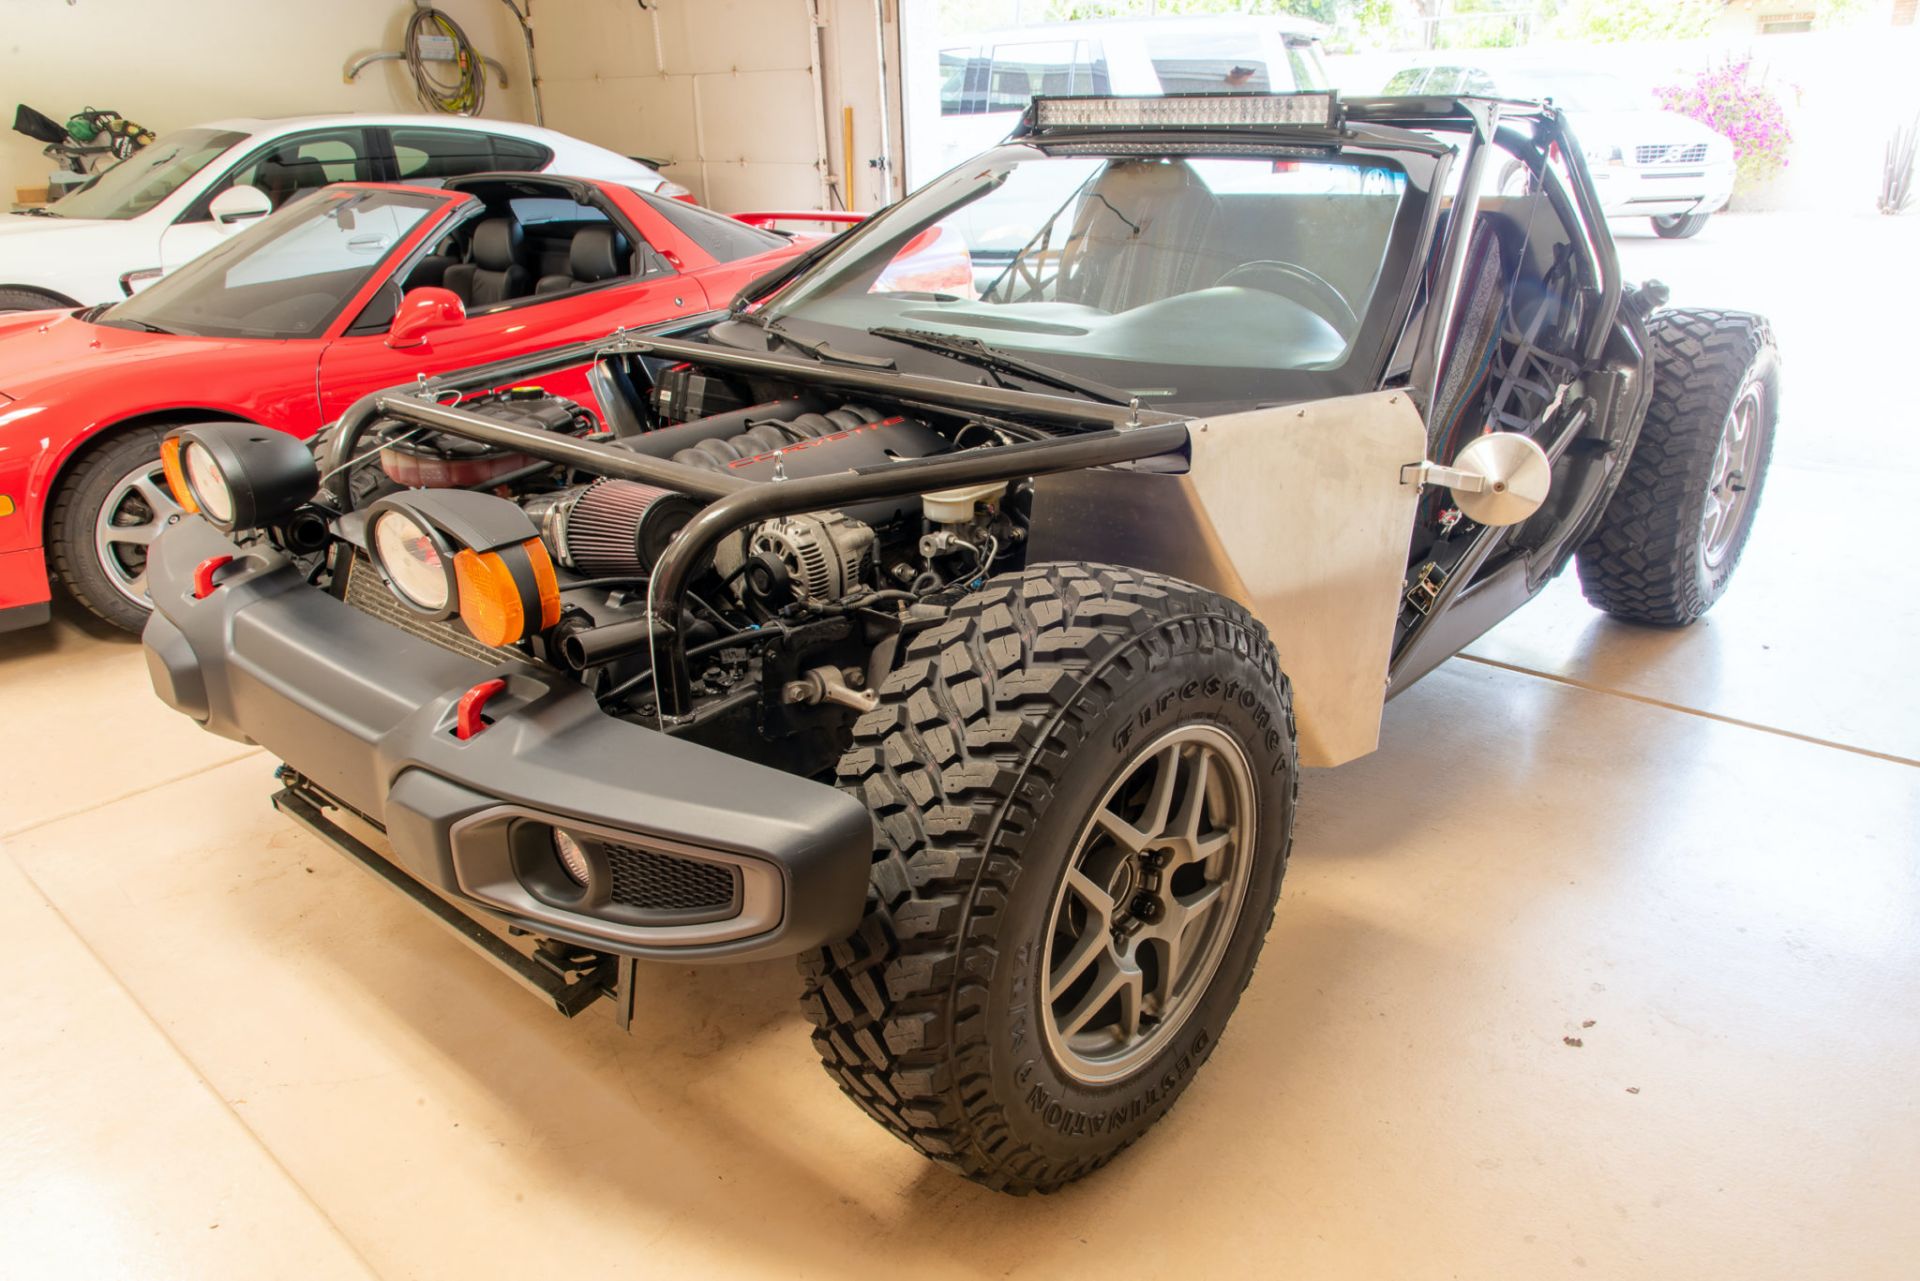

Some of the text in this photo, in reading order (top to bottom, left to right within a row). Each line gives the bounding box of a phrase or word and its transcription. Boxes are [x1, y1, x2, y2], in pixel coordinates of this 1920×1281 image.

[728, 416, 905, 468] CORVETTE
[1113, 674, 1281, 753] Firestone
[1025, 1028, 1210, 1138] DESTINATION
